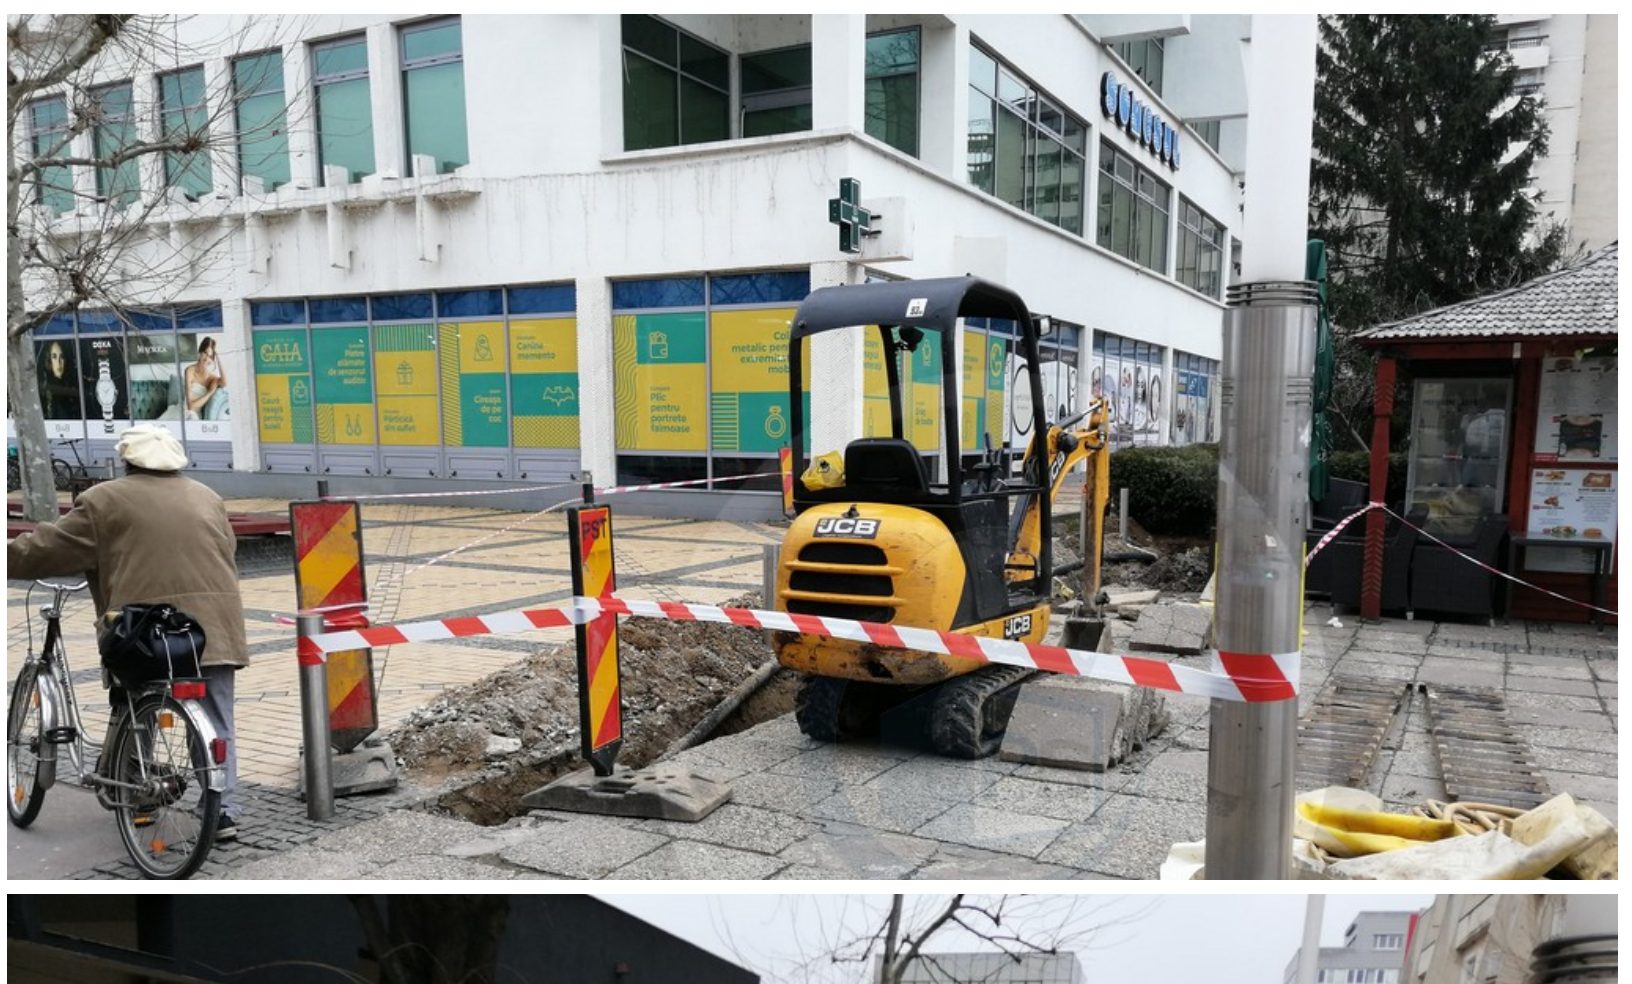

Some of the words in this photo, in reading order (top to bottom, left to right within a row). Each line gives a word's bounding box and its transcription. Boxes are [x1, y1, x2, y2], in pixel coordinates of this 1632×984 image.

[581, 518, 607, 540] PST
[816, 519, 877, 535] JCB
[1005, 615, 1030, 637] JCB
